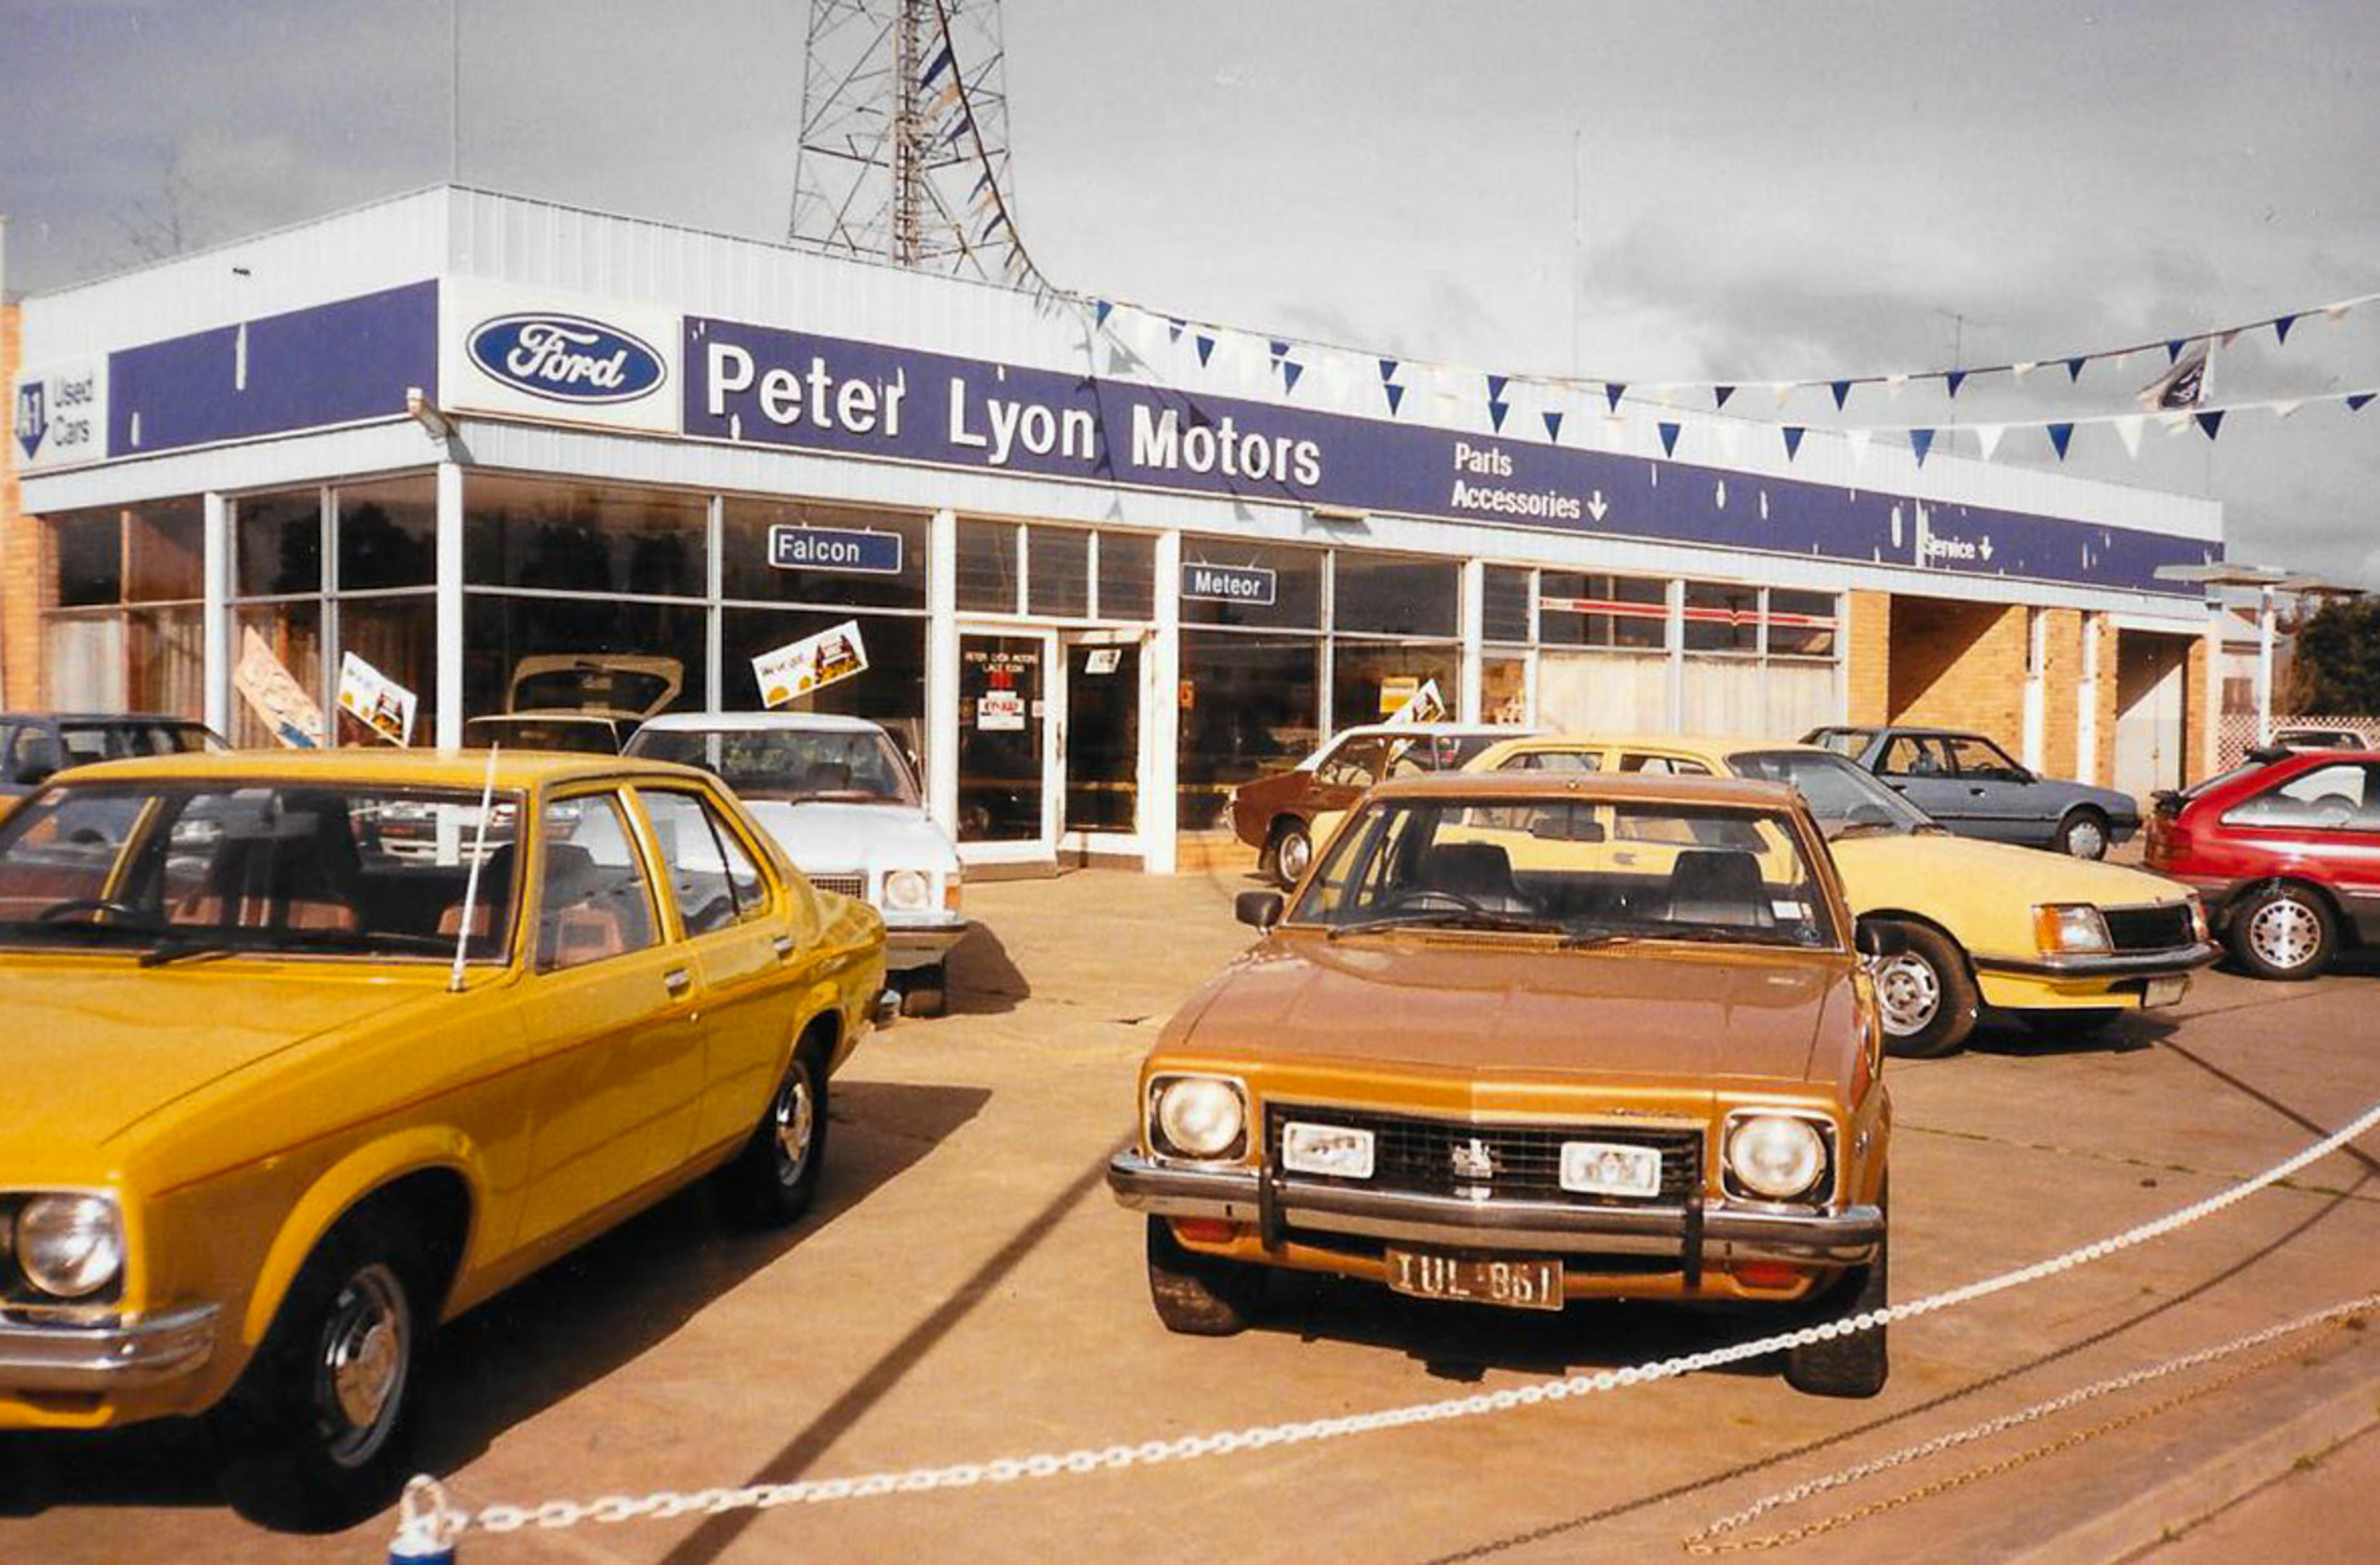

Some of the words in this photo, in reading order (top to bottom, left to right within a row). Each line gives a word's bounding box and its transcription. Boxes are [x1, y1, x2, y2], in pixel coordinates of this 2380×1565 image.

[506, 322, 627, 389] Ford
[54, 372, 93, 407] Used
[53, 415, 89, 446] Cars
[708, 342, 906, 436] Peter
[950, 377, 1095, 464] Lyon
[1132, 404, 1321, 486] Motors
[1454, 443, 1513, 477] Parts
[1452, 480, 1580, 519] Accessories
[778, 534, 861, 563] Falcon
[1923, 532, 1976, 559] Service
[1194, 570, 1263, 597] Meteor
